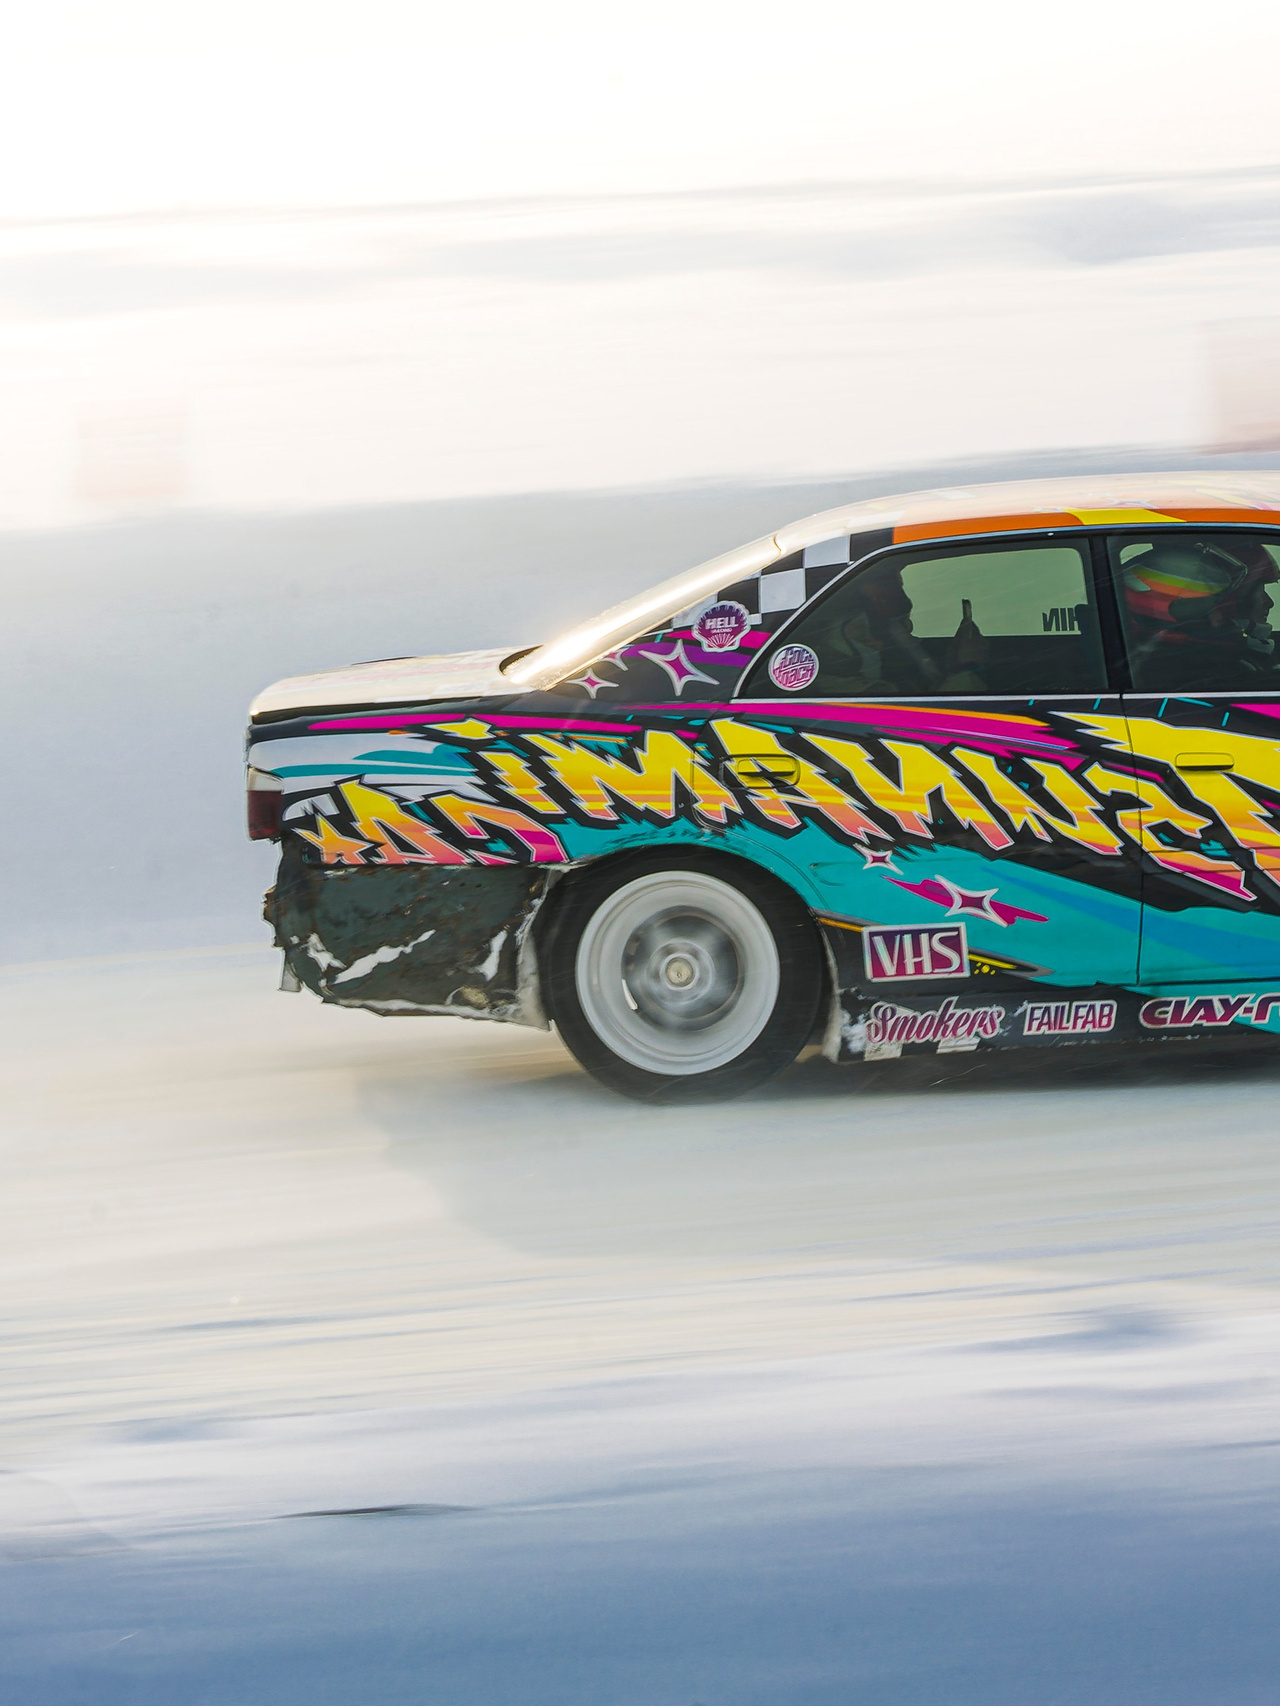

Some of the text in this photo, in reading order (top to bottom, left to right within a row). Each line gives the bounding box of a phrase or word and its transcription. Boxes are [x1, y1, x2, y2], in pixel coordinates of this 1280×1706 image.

[705, 616, 739, 630] HELL
[871, 930, 962, 976] VHS
[866, 996, 1003, 1043] Smokers
